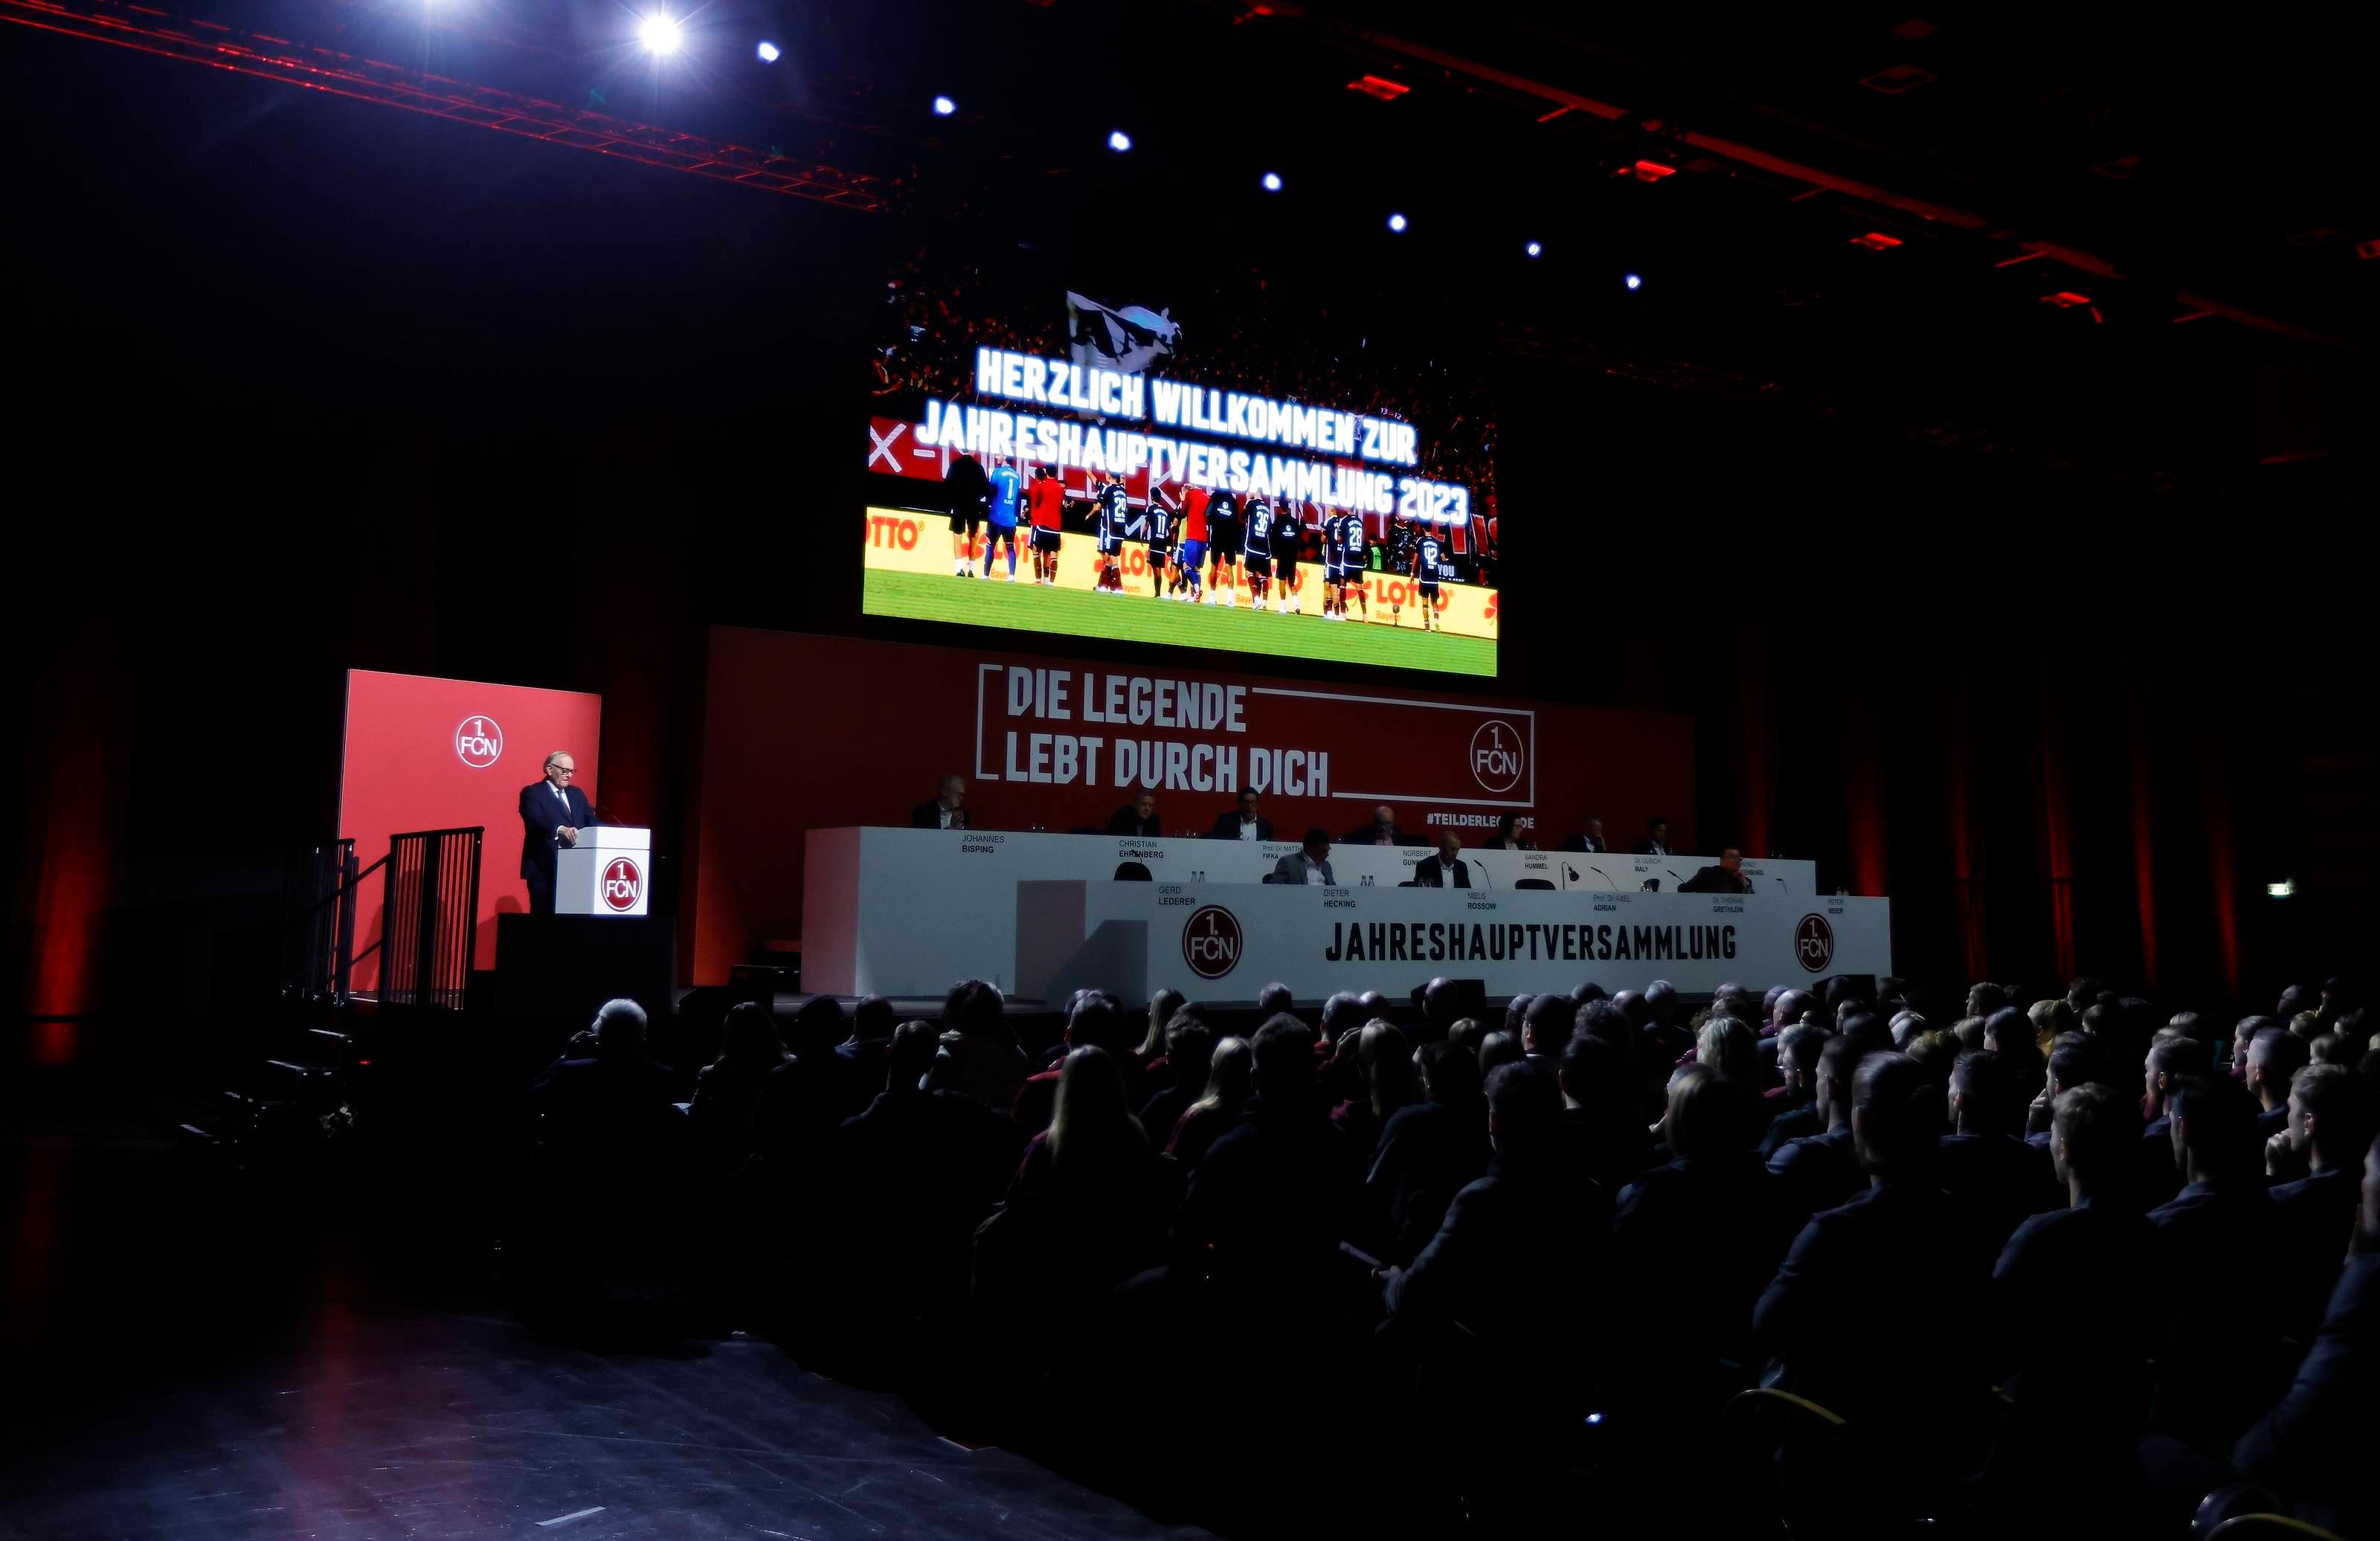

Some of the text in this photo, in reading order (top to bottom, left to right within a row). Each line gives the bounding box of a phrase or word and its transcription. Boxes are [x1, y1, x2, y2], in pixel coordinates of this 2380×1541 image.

[978, 348, 1417, 464] HERZLICH WILLKOMMEN ZUR
[916, 401, 1393, 514] JAHRESHAUPTVERSAMMLUNG
[1400, 478, 1468, 525] 2023
[1008, 478, 1013, 499] 1
[1114, 497, 1126, 518] 29
[1157, 515, 1166, 534] 11
[1255, 511, 1269, 533] 36
[866, 515, 918, 550] TTO
[1349, 527, 1363, 547] 28
[1424, 547, 1438, 565] 42
[1438, 564, 1455, 576] YOU
[1008, 666, 1247, 732] DIE LEGENDE
[461, 736, 498, 756] FCN
[1006, 731, 1328, 797] LEBT DURCH DICH
[1476, 749, 1517, 775] FCN
[962, 834, 1004, 843] JOHANNES
[1119, 840, 1157, 848] CHRISTIAN
[962, 845, 994, 853] BISPING
[606, 880, 637, 898] FCN
[1159, 886, 1181, 894] GERD
[1324, 889, 1349, 897] DIETER
[1159, 897, 1195, 906] LEDERER
[1324, 900, 1356, 908] HECKING
[1191, 936, 1234, 960] FCN
[1325, 922, 1736, 962] JAHRESHAUPTVERSAMMLUNG
[1800, 938, 1829, 958] FCN
